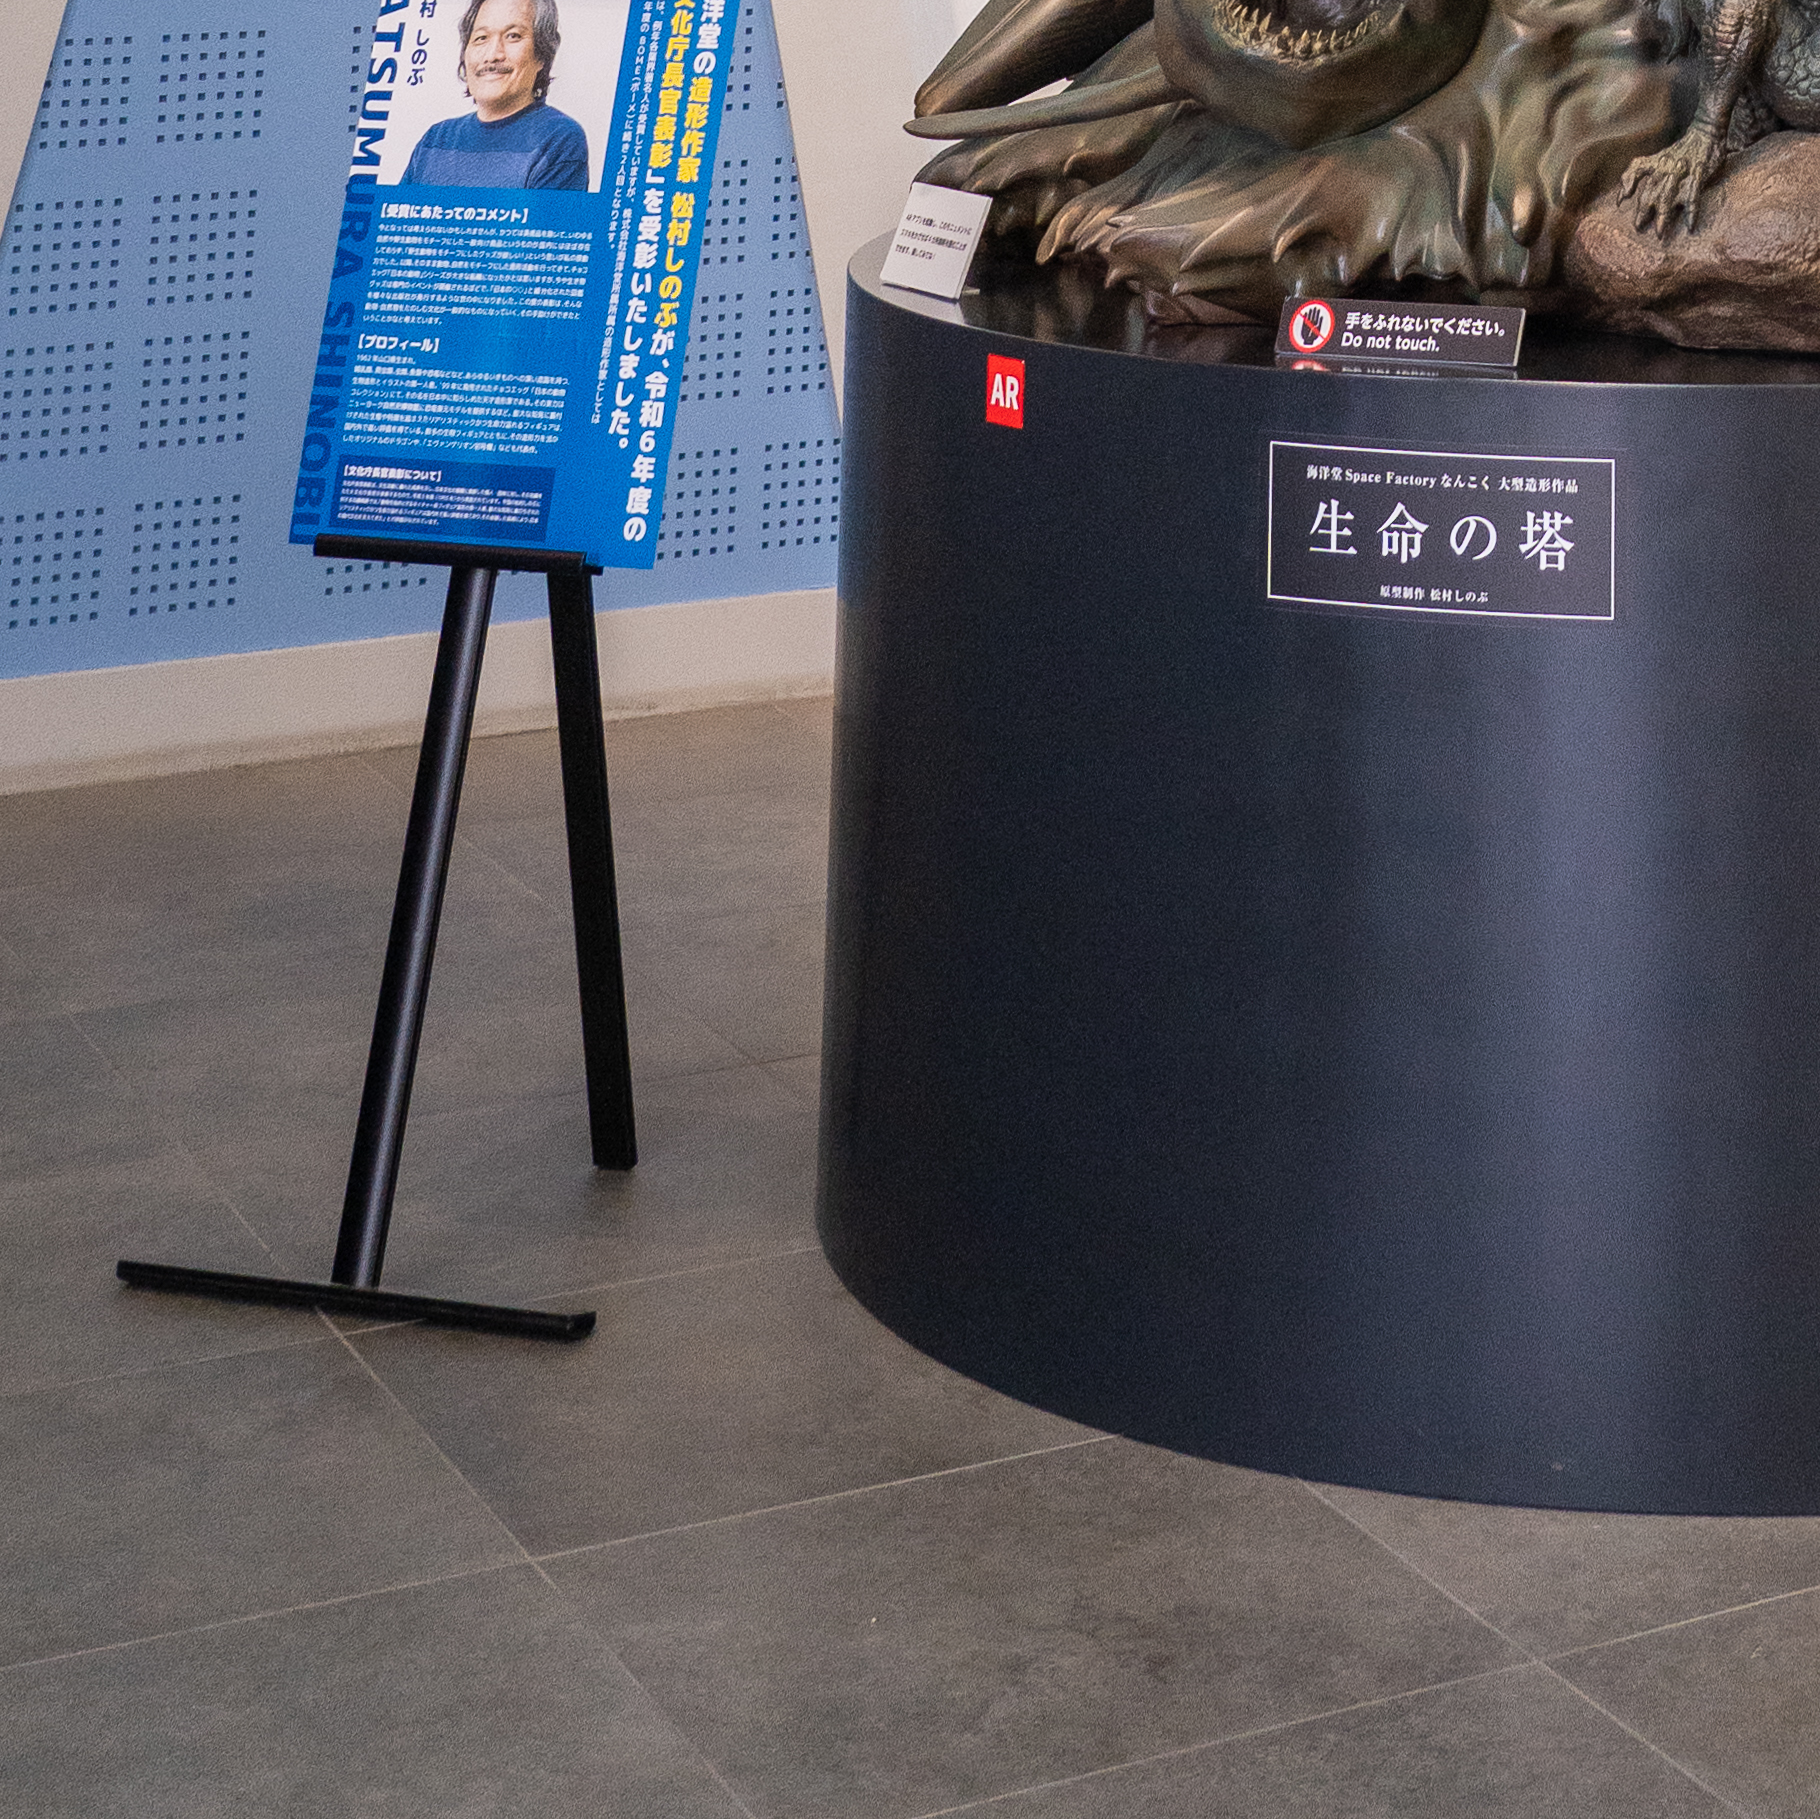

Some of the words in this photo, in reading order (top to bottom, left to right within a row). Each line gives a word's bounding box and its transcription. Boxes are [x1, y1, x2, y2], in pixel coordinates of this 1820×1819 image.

[406, 28, 430, 87] しのぶ
[1345, 311, 1505, 337] 手をふれないでください。
[357, 333, 440, 354] 【プロフィール】
[1341, 332, 1363, 347] Do
[1366, 334, 1392, 349] not
[1395, 335, 1440, 352] touch.
[622, 191, 697, 543] 松村しのぶが、令和6年度の
[990, 373, 1019, 411] AR
[1345, 468, 1382, 484] Space
[1385, 470, 1436, 489] Factory
[1440, 473, 1490, 491] なんこく
[1498, 475, 1579, 494] 大型造形作品
[1308, 498, 1575, 572] 生命の塔
[1379, 584, 1425, 601] 原型制作
[1429, 586, 1489, 603] 松村しのぶ
